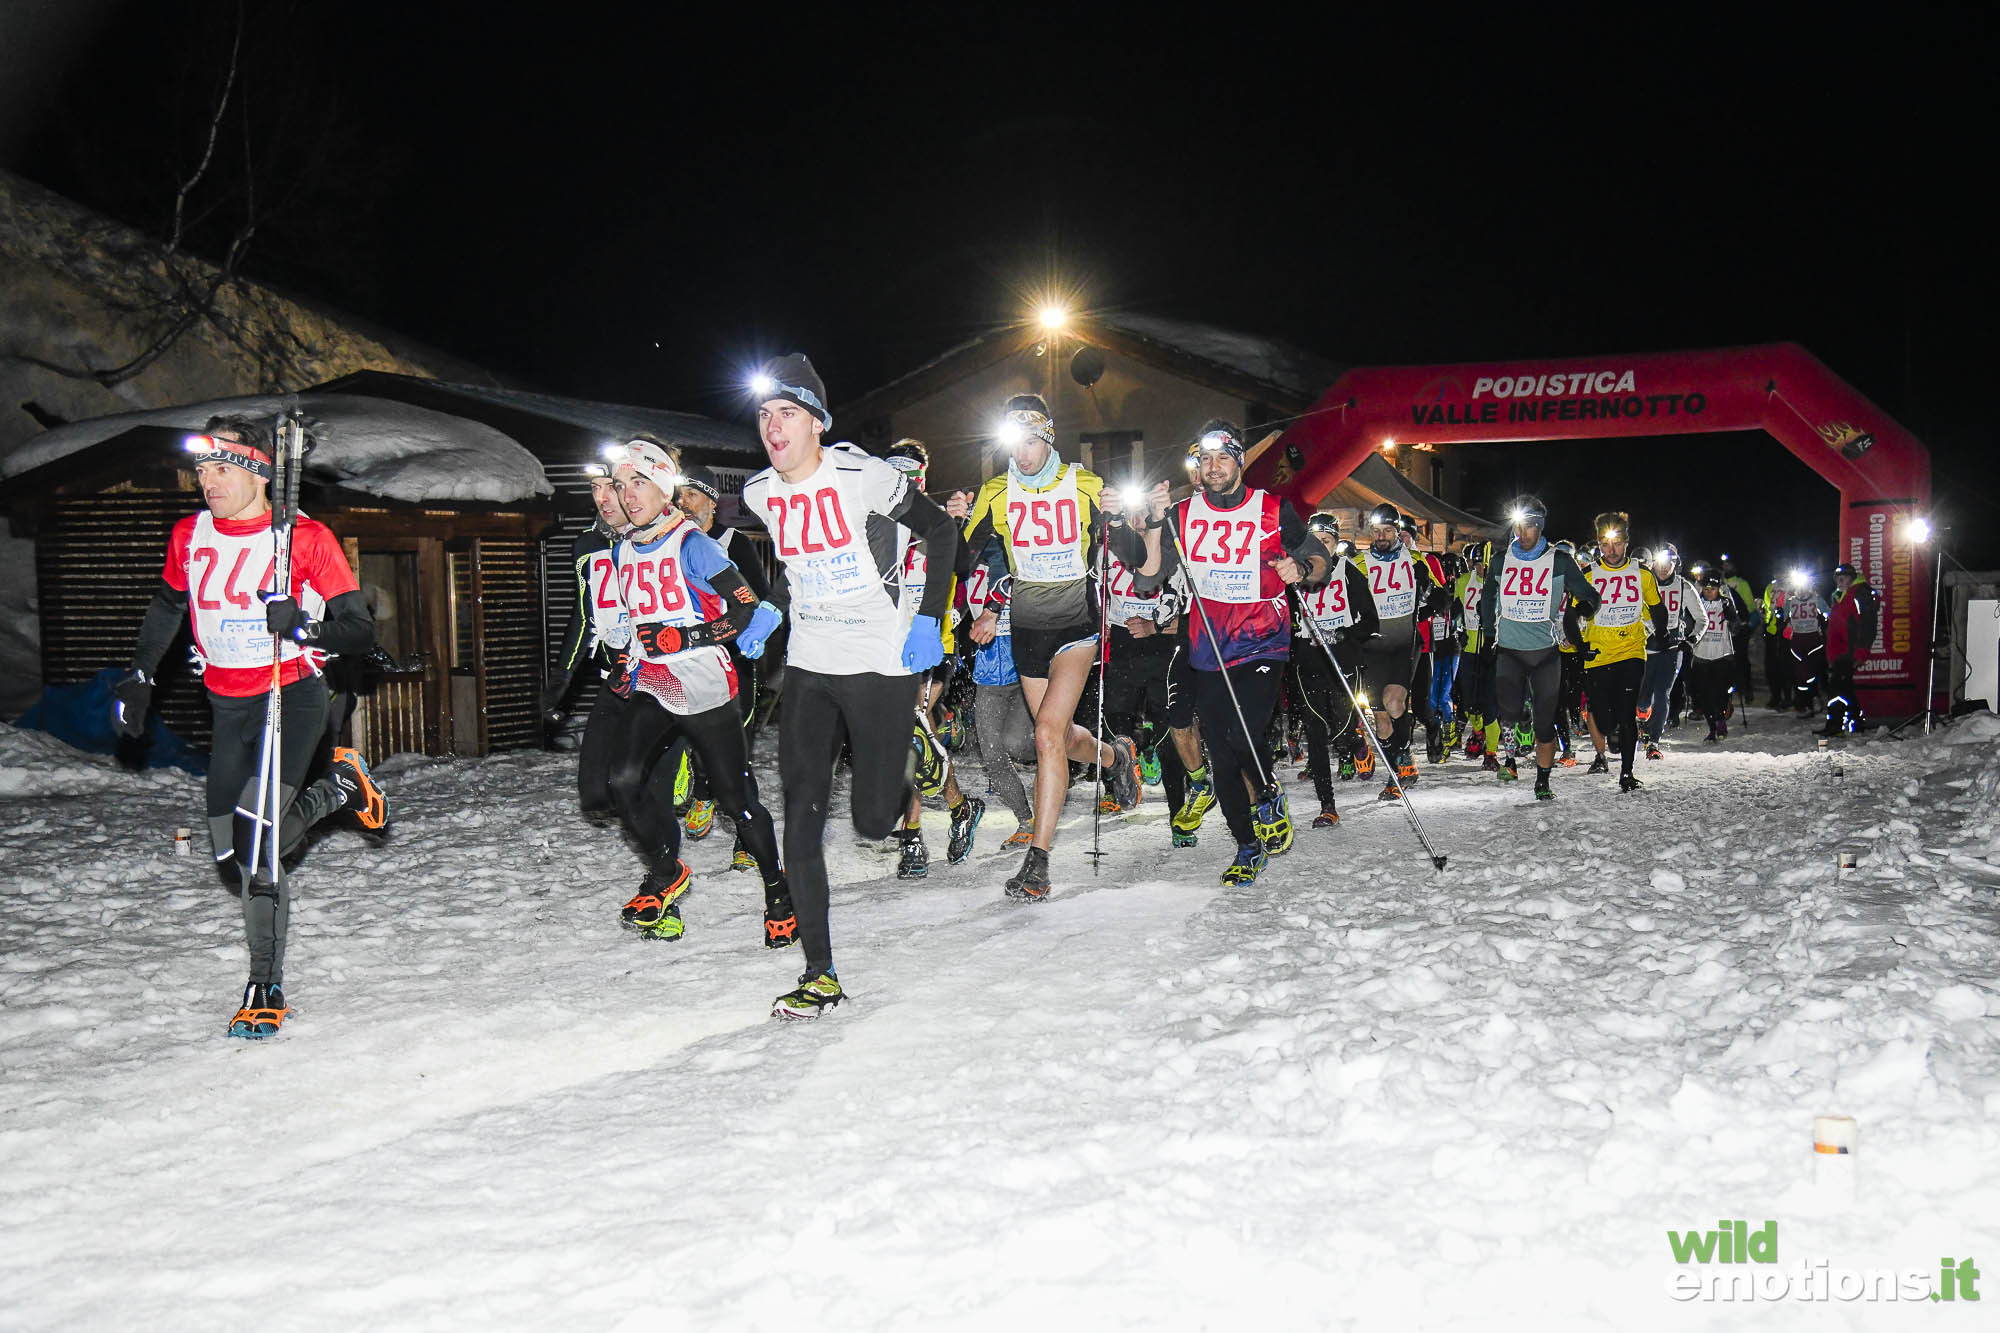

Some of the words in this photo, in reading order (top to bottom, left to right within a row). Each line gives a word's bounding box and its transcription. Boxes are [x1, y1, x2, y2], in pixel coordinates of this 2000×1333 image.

[1472, 370, 1635, 399] PODISTICA
[1411, 402, 1498, 425] VALLE
[1507, 393, 1706, 422] INFERNOTTO
[767, 486, 852, 556] 220
[1008, 498, 1077, 547] 250
[1190, 519, 1256, 565] 237
[620, 557, 687, 618] 258
[1369, 561, 1414, 594] 241
[1503, 567, 1549, 596] 284
[1594, 575, 1640, 605] 275
[1791, 603, 1817, 620] 263
[1892, 617, 1912, 653] UGO
